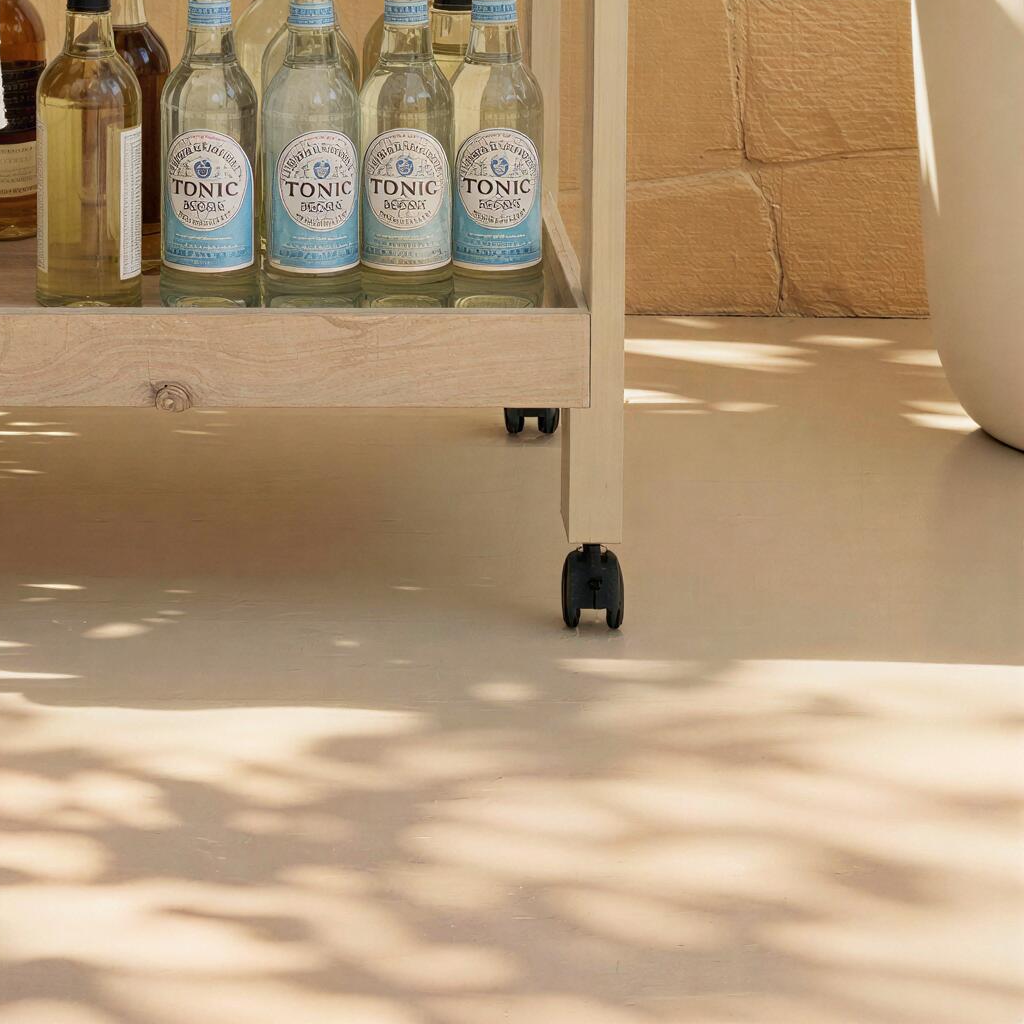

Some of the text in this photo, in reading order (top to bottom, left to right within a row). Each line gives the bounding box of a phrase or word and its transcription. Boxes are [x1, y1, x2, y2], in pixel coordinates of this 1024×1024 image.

[173, 179, 238, 197] TONIC
[285, 180, 352, 198] TONIC
[462, 177, 531, 196] TONIC
